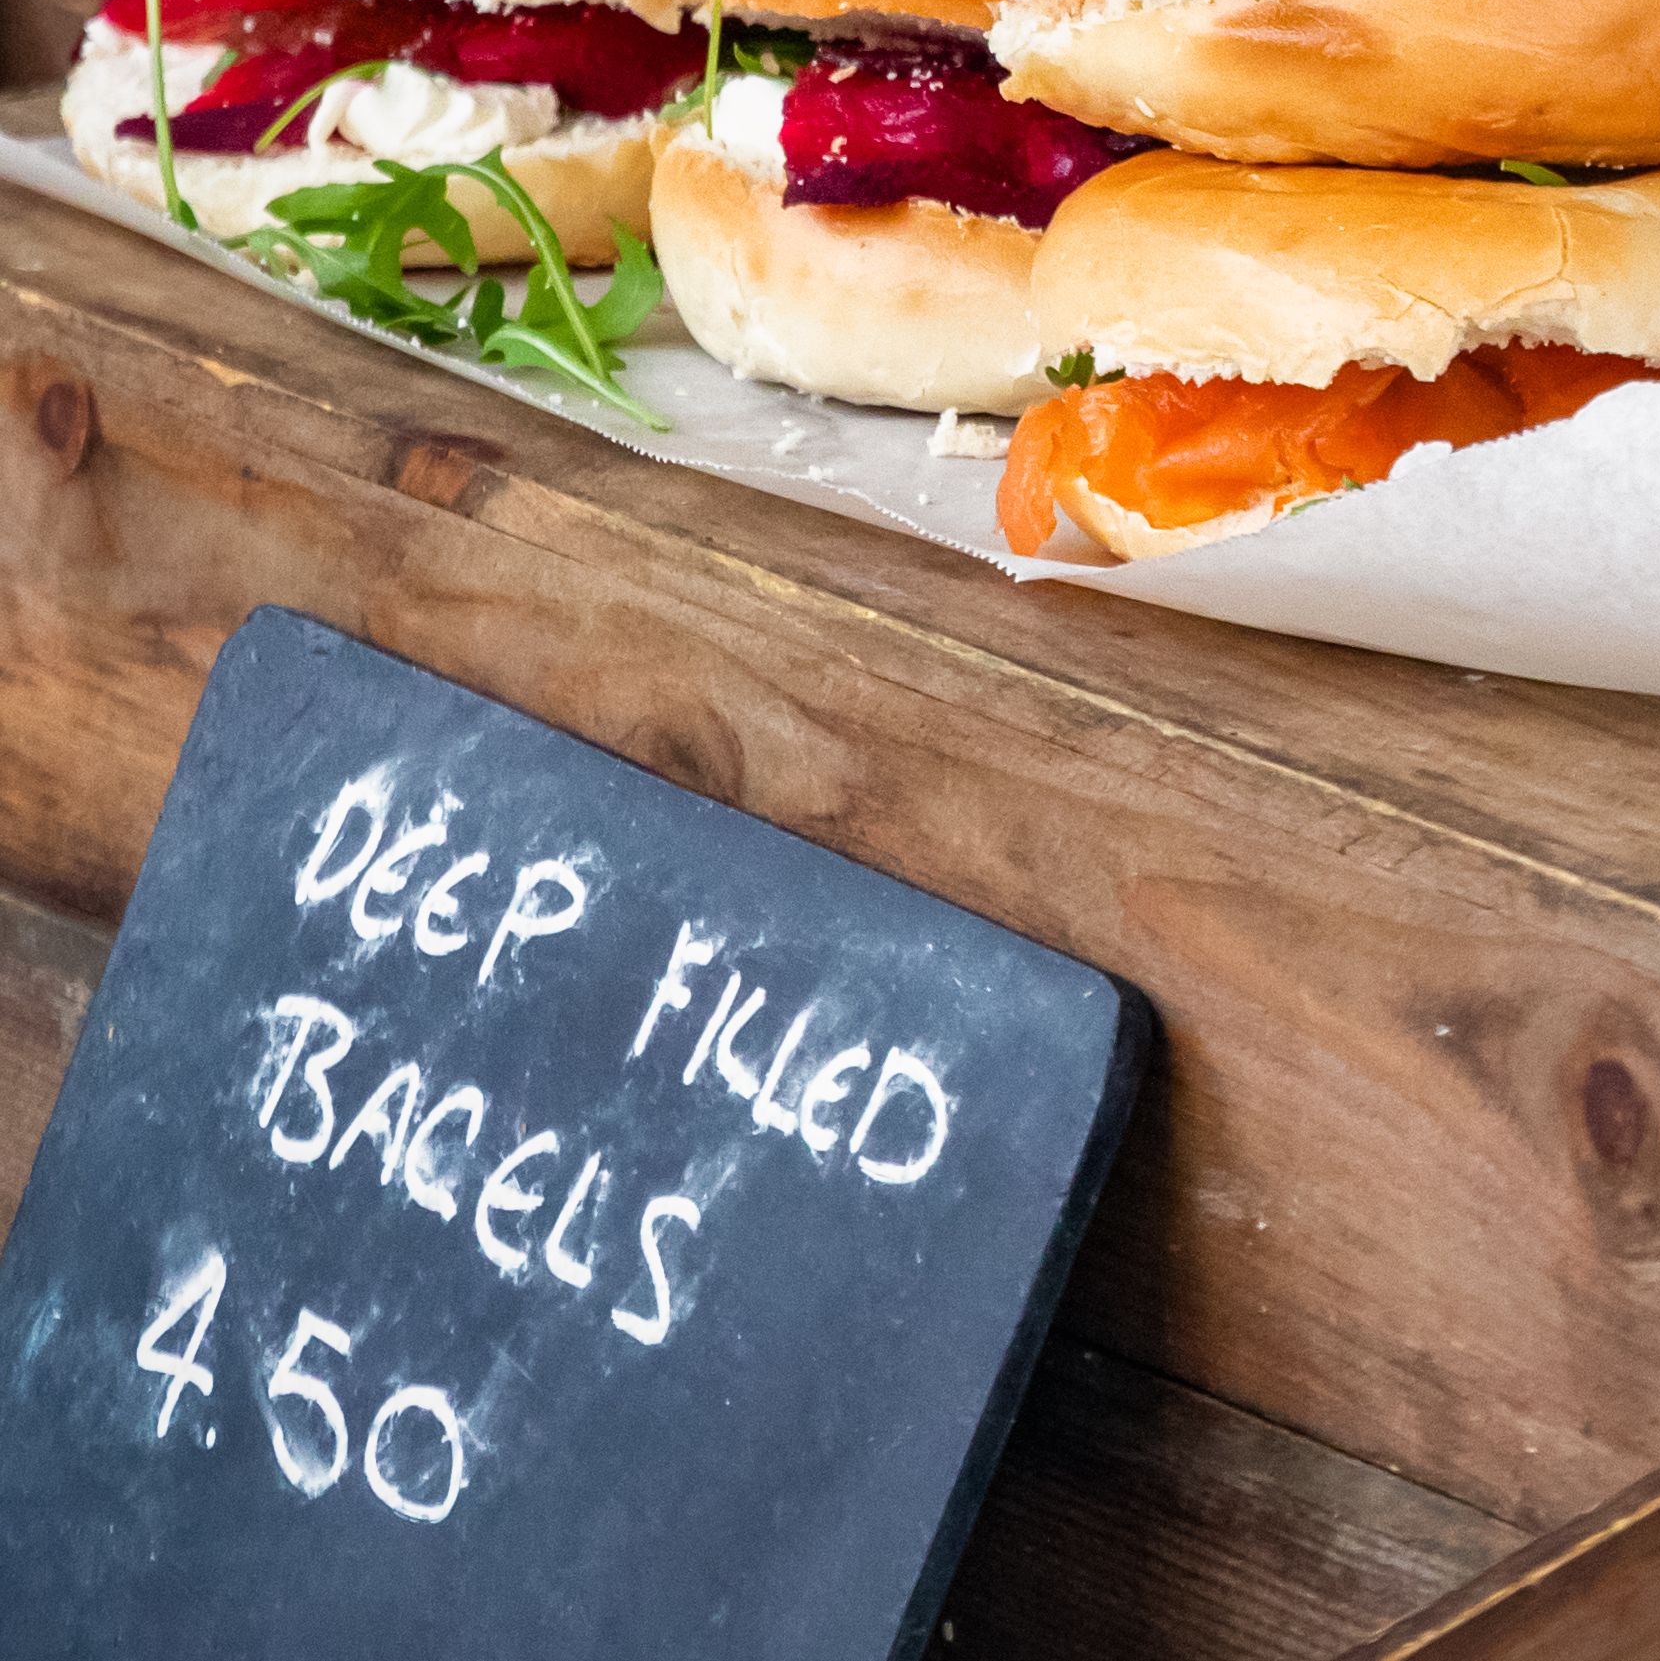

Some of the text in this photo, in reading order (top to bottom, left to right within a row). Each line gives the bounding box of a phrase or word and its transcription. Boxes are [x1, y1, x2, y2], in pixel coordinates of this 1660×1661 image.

[294, 770, 949, 1185] DEEP FILLED
[258, 993, 702, 1345] BAGELS
[136, 1249, 464, 1523] 4.50
